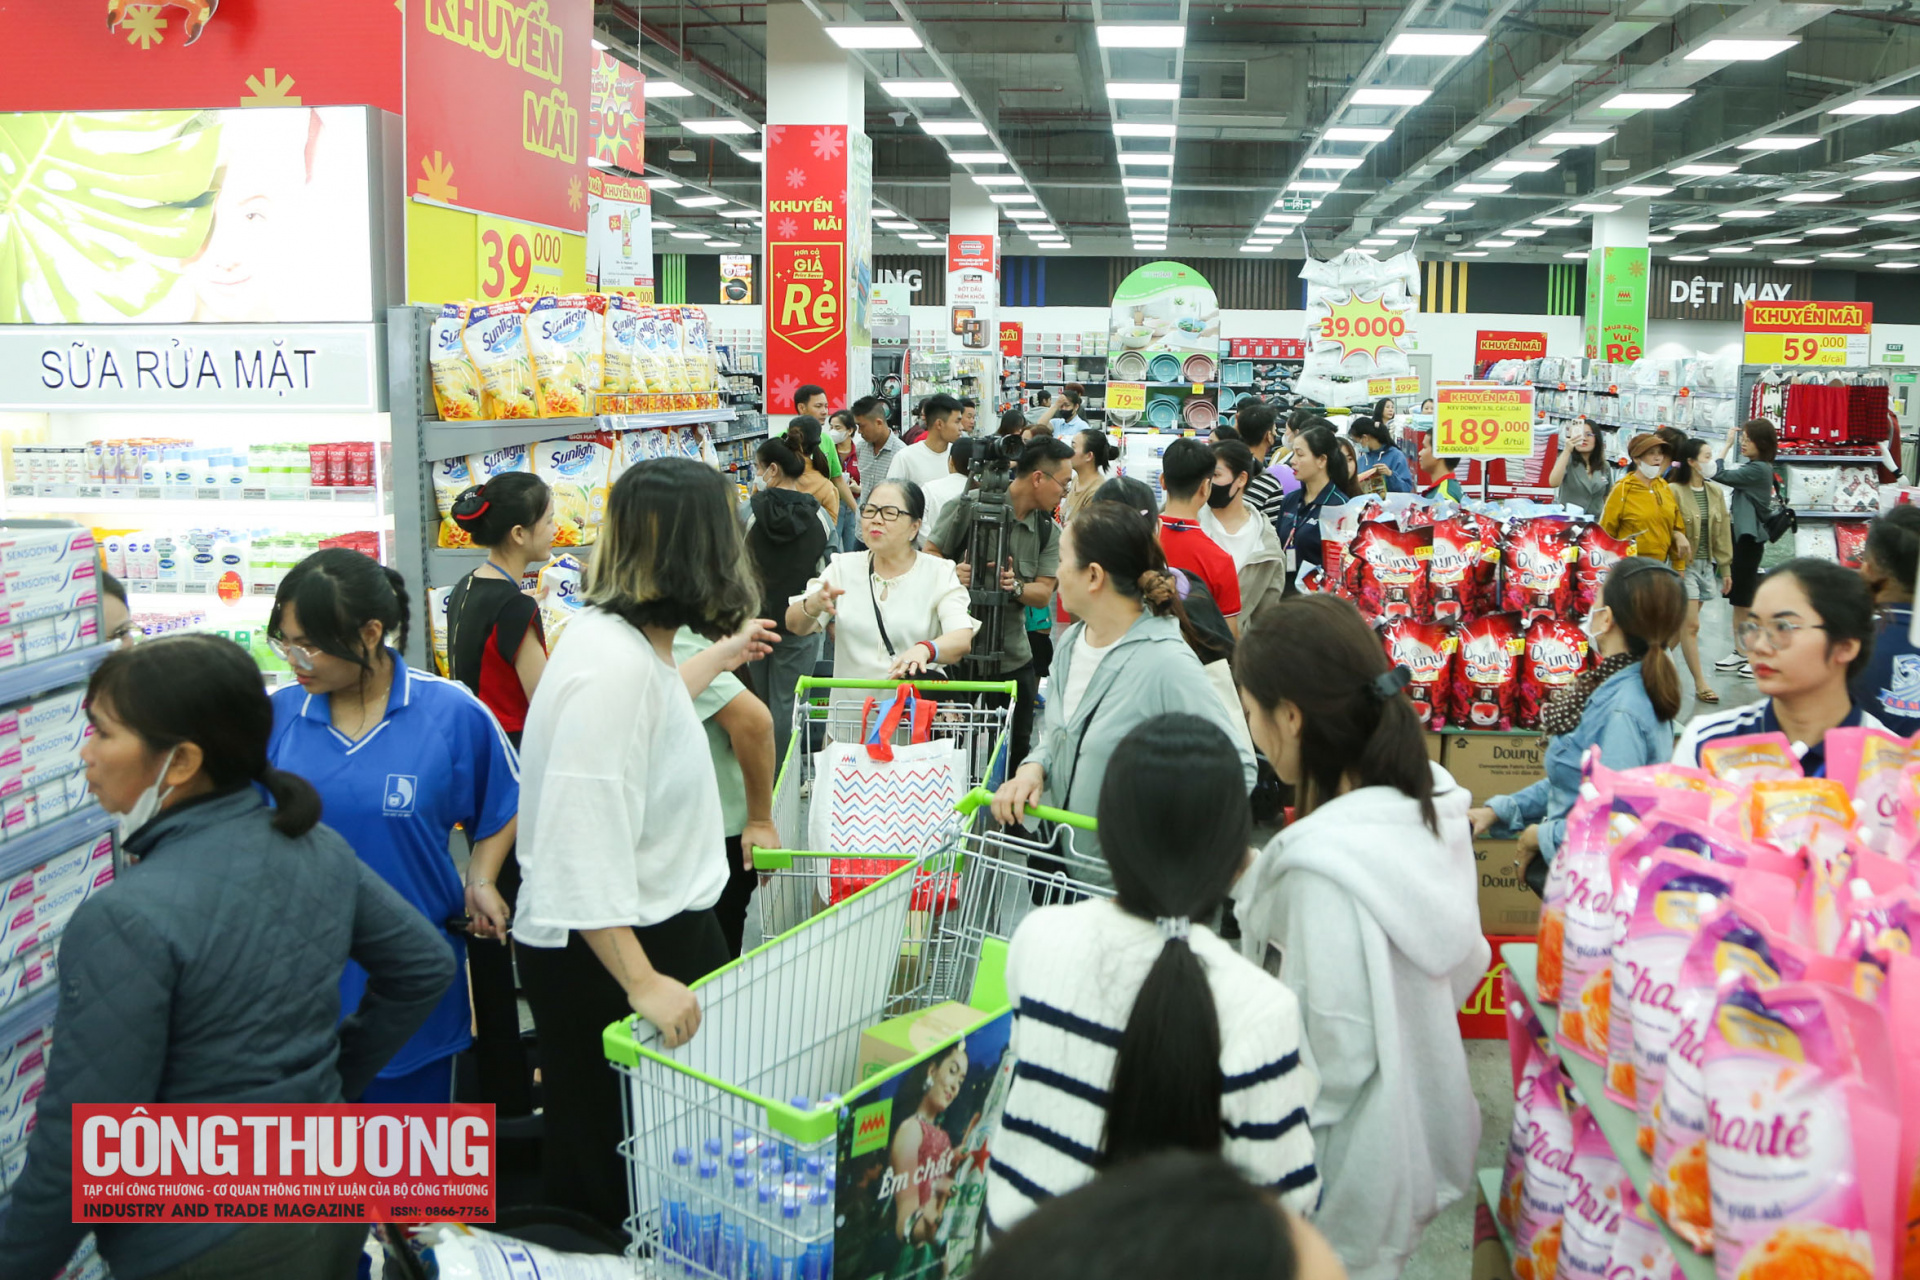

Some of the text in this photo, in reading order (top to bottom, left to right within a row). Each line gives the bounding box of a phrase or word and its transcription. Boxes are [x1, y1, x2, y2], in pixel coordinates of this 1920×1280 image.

[425, 0, 563, 85] KHUYẾN
[523, 88, 578, 164] MÃI
[603, 182, 648, 203] KHUYẾN MÃI
[769, 195, 833, 213] KHUYẾN
[813, 215, 843, 231] MÃI
[481, 229, 561, 298] 39 000
[794, 255, 824, 272] GIÁ
[781, 279, 837, 327] Rẻ
[1669, 275, 1793, 309] DỆT MAY
[1753, 303, 1863, 326] KHUYẾN MÃI
[482, 314, 523, 351] Sunlight
[1321, 316, 1405, 337] 39.000
[1481, 338, 1542, 351] KHUYẾN MÃI
[1784, 338, 1818, 362] 59
[41, 338, 316, 397] SỮA RỬA MẶT
[1116, 394, 1132, 406] 79
[1450, 390, 1520, 403] KHUYẾN MÃI
[1441, 418, 1500, 446] 189
[7, 544, 59, 561] SENSODYNE
[11, 573, 61, 592] SENSODYNE
[25, 704, 71, 727] SENSODYNE
[27, 733, 73, 756] SENSODYNE
[1493, 746, 1539, 763] Downy
[39, 856, 83, 886] SENSODYNE
[39, 886, 83, 915] SENSODYNE
[877, 1165, 909, 1201] Êm
[913, 1146, 955, 1185] chất
